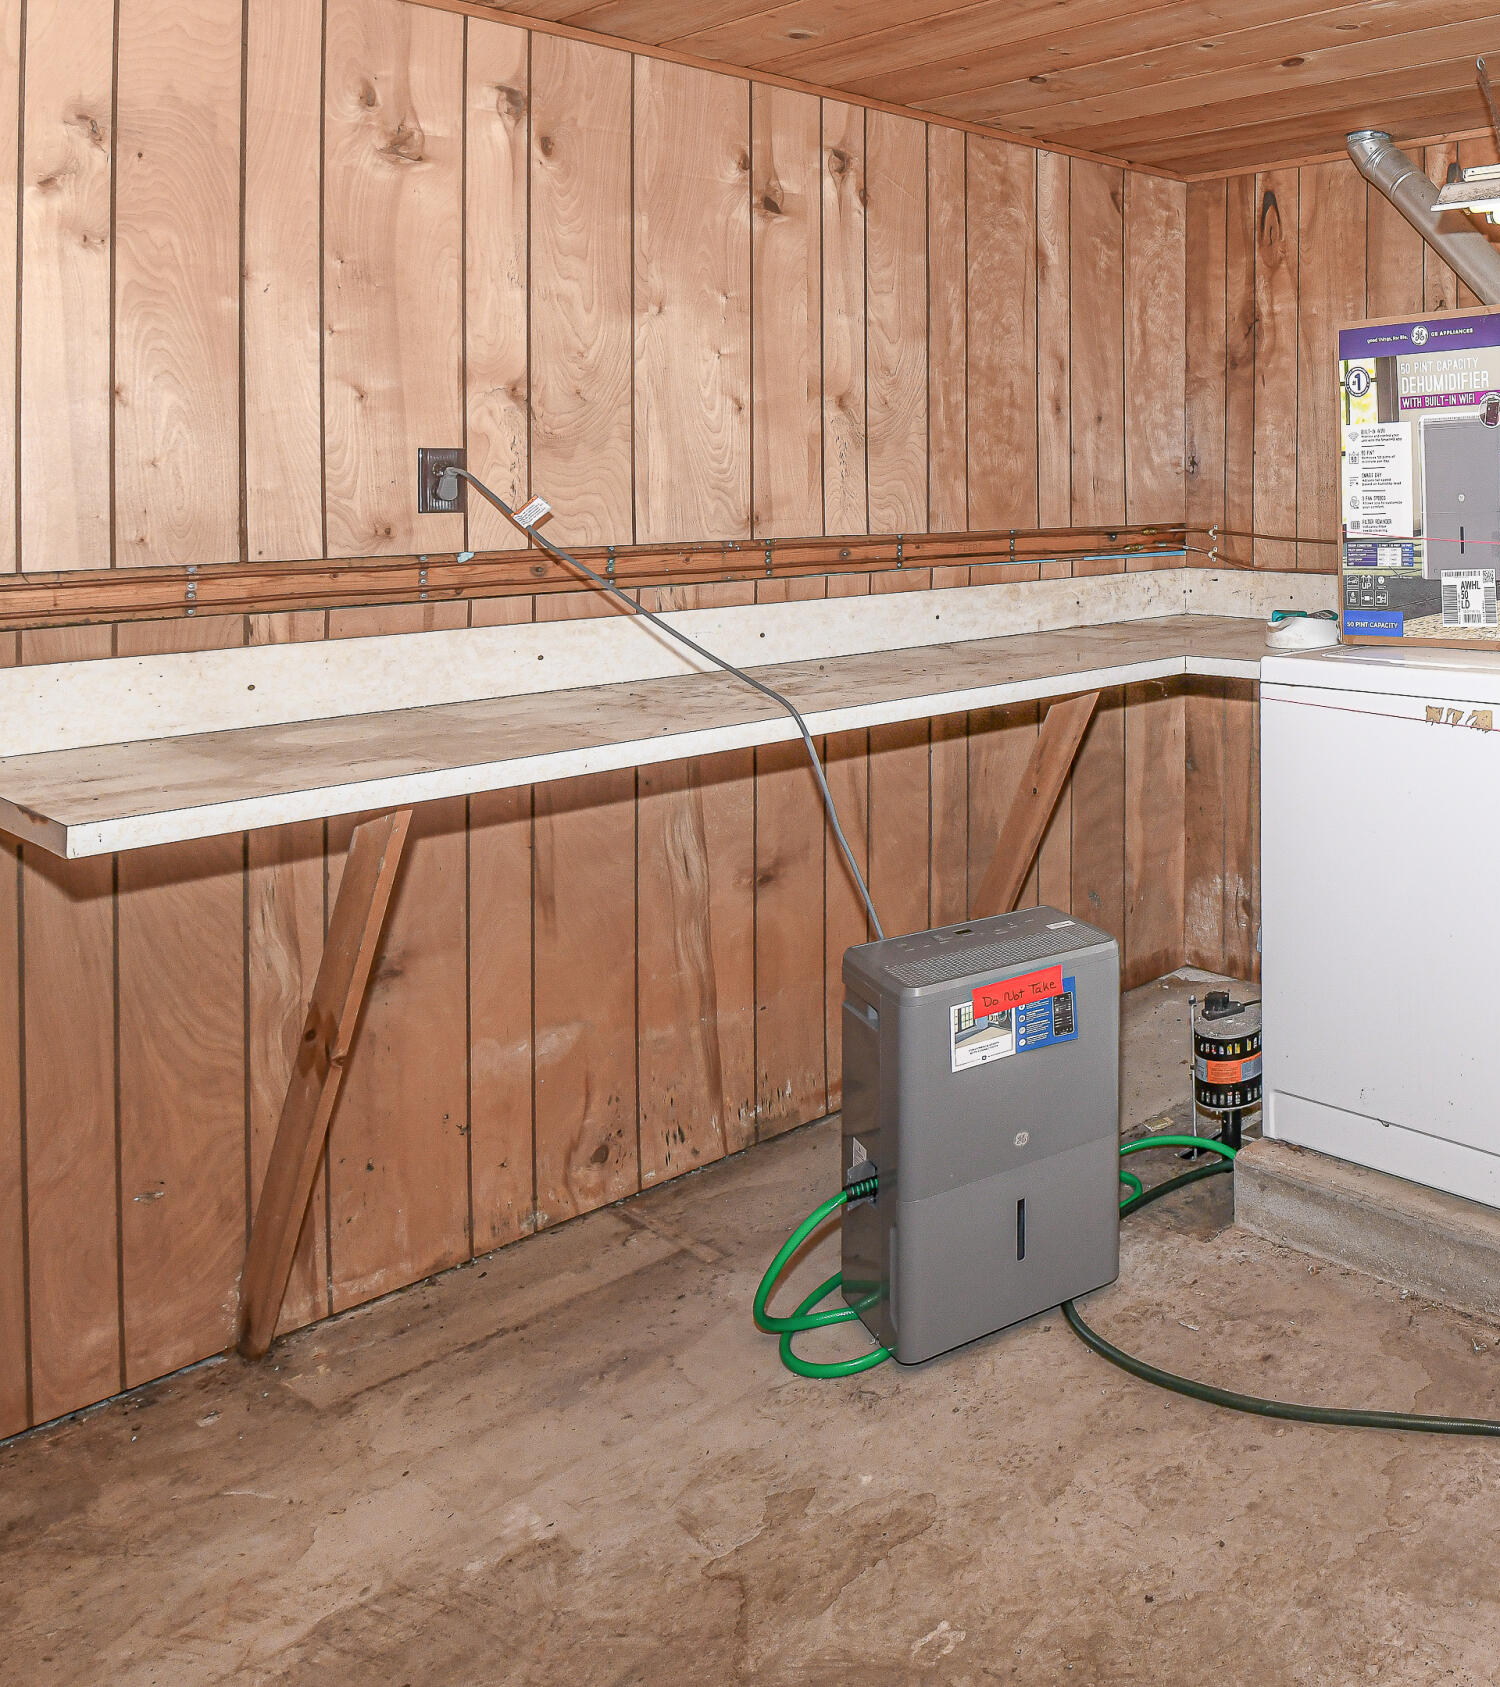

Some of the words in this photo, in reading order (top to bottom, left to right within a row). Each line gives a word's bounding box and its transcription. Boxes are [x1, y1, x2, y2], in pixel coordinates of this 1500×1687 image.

[1440, 328, 1473, 336] APPLIANCES
[1401, 363, 1410, 373] 50
[1414, 361, 1433, 373] PINT
[1436, 357, 1479, 371] CAPACITY
[1402, 370, 1489, 394] DEHUMIDIFIER
[1402, 396, 1422, 408] WITH
[1425, 394, 1456, 406] BUILT-IN
[1459, 393, 1475, 404] WIFI
[1460, 580, 1480, 590] AWHL
[1461, 590, 1468, 600] 50
[1461, 600, 1470, 609] LD
[982, 996, 999, 1007] Do
[1004, 990, 1024, 1001] Not
[1028, 981, 1056, 994] Take
